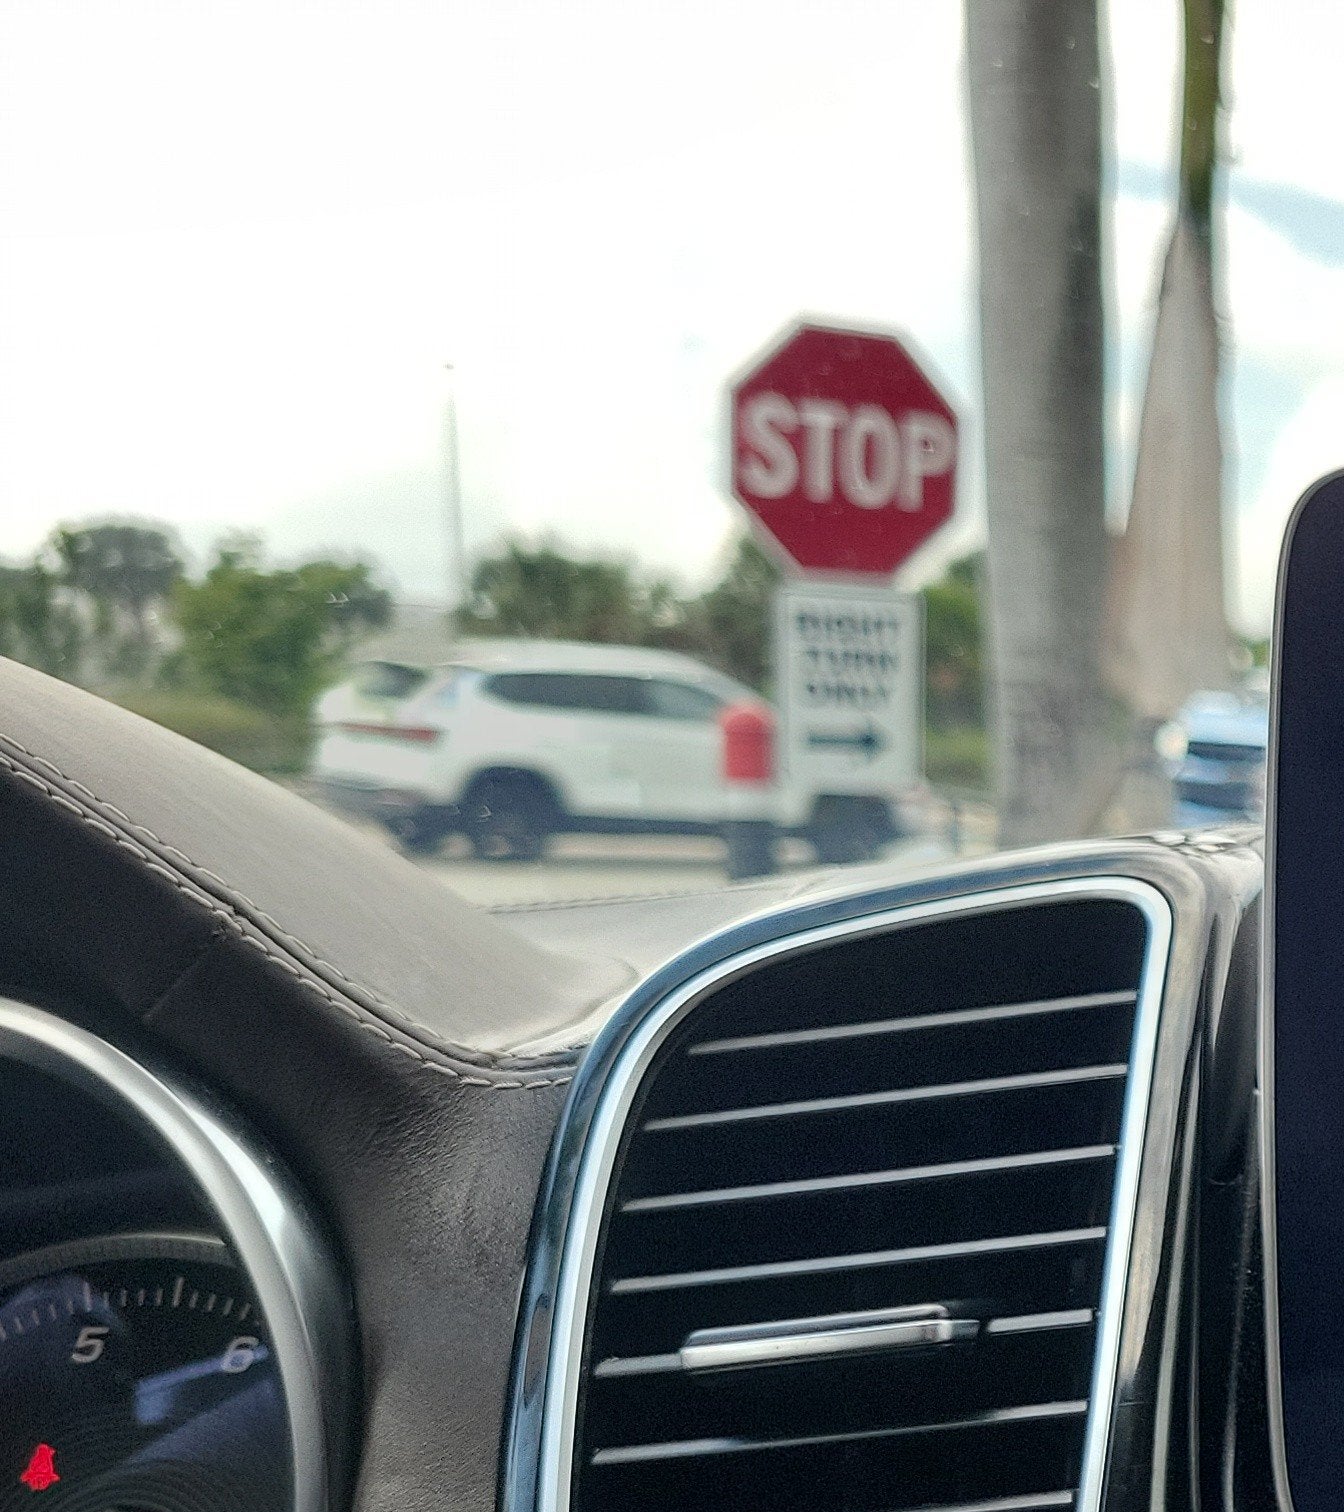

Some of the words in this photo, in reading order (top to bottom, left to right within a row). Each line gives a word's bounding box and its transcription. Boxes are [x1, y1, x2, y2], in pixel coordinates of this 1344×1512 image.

[738, 391, 955, 512] STOP
[71, 1326, 110, 1364] 5
[220, 1336, 260, 1374] 6
